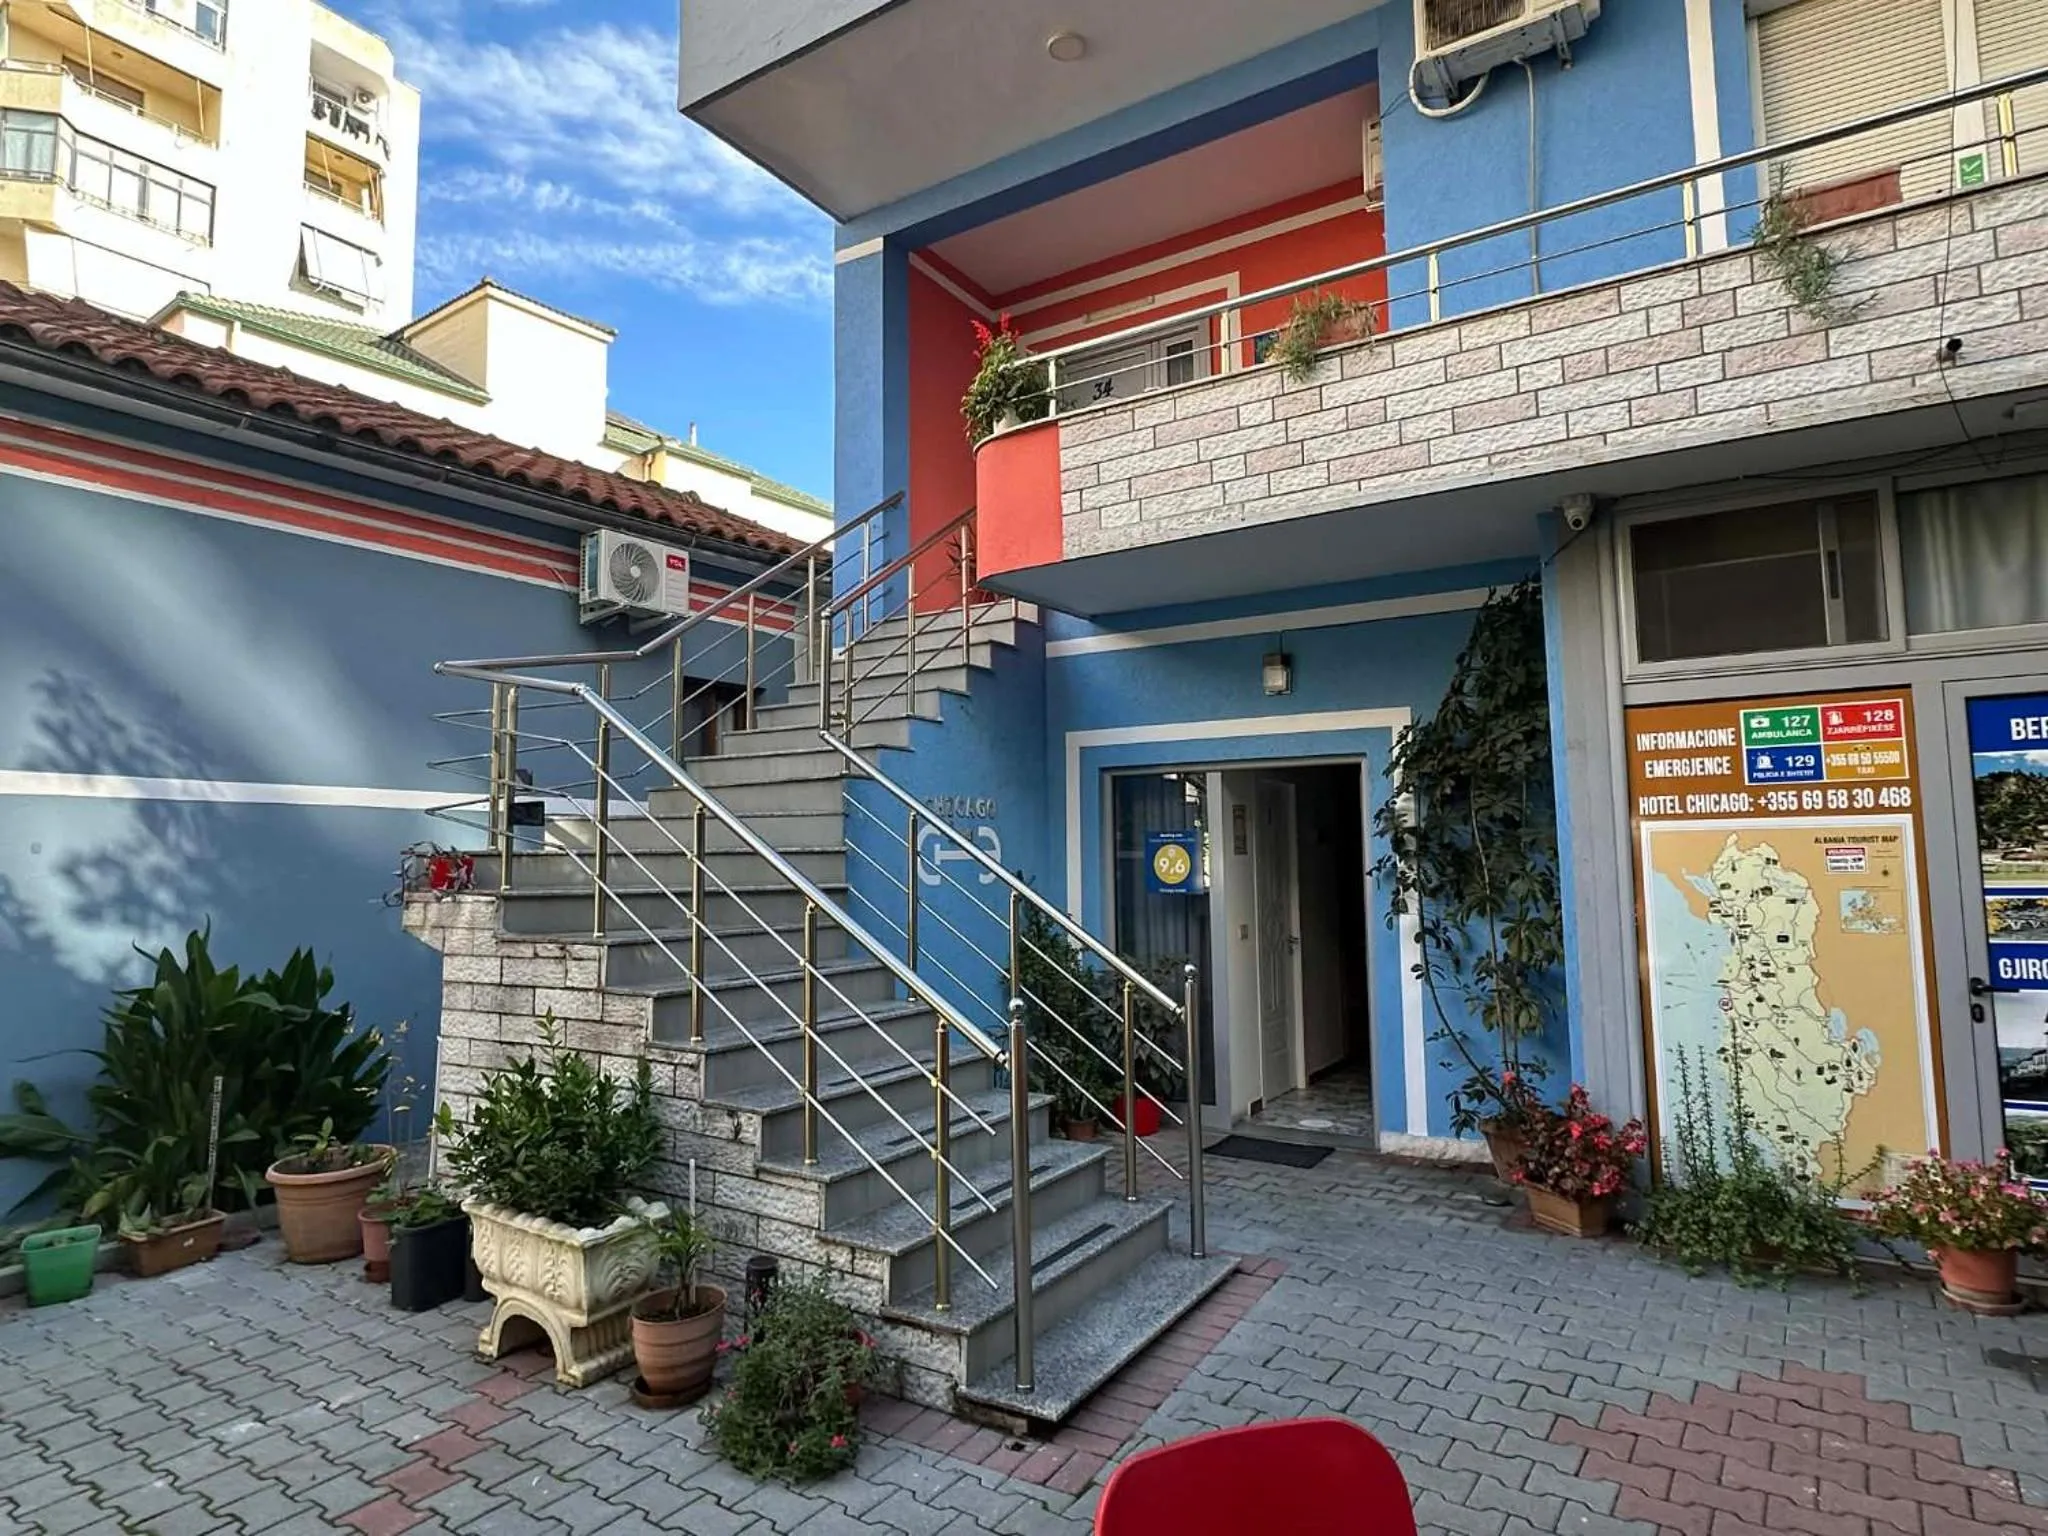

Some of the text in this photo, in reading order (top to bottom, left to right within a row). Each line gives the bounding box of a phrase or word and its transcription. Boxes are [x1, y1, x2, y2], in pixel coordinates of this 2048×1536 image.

[1093, 377, 1114, 400] 34
[1781, 714, 1811, 728] 127
[1863, 709, 1895, 723] 128
[1636, 727, 1737, 752] INFORMACIONE
[1751, 729, 1813, 740] AMBULANCA
[1644, 755, 1732, 779] EMERGJENCE
[1784, 755, 1816, 768] 129
[1639, 785, 1911, 815] HOTEL CHICAGO: +355 69 58 30 468
[1814, 835, 1845, 844] ALBANIA
[1881, 834, 1899, 843] MAP
[1159, 857, 1186, 875] 9,6
